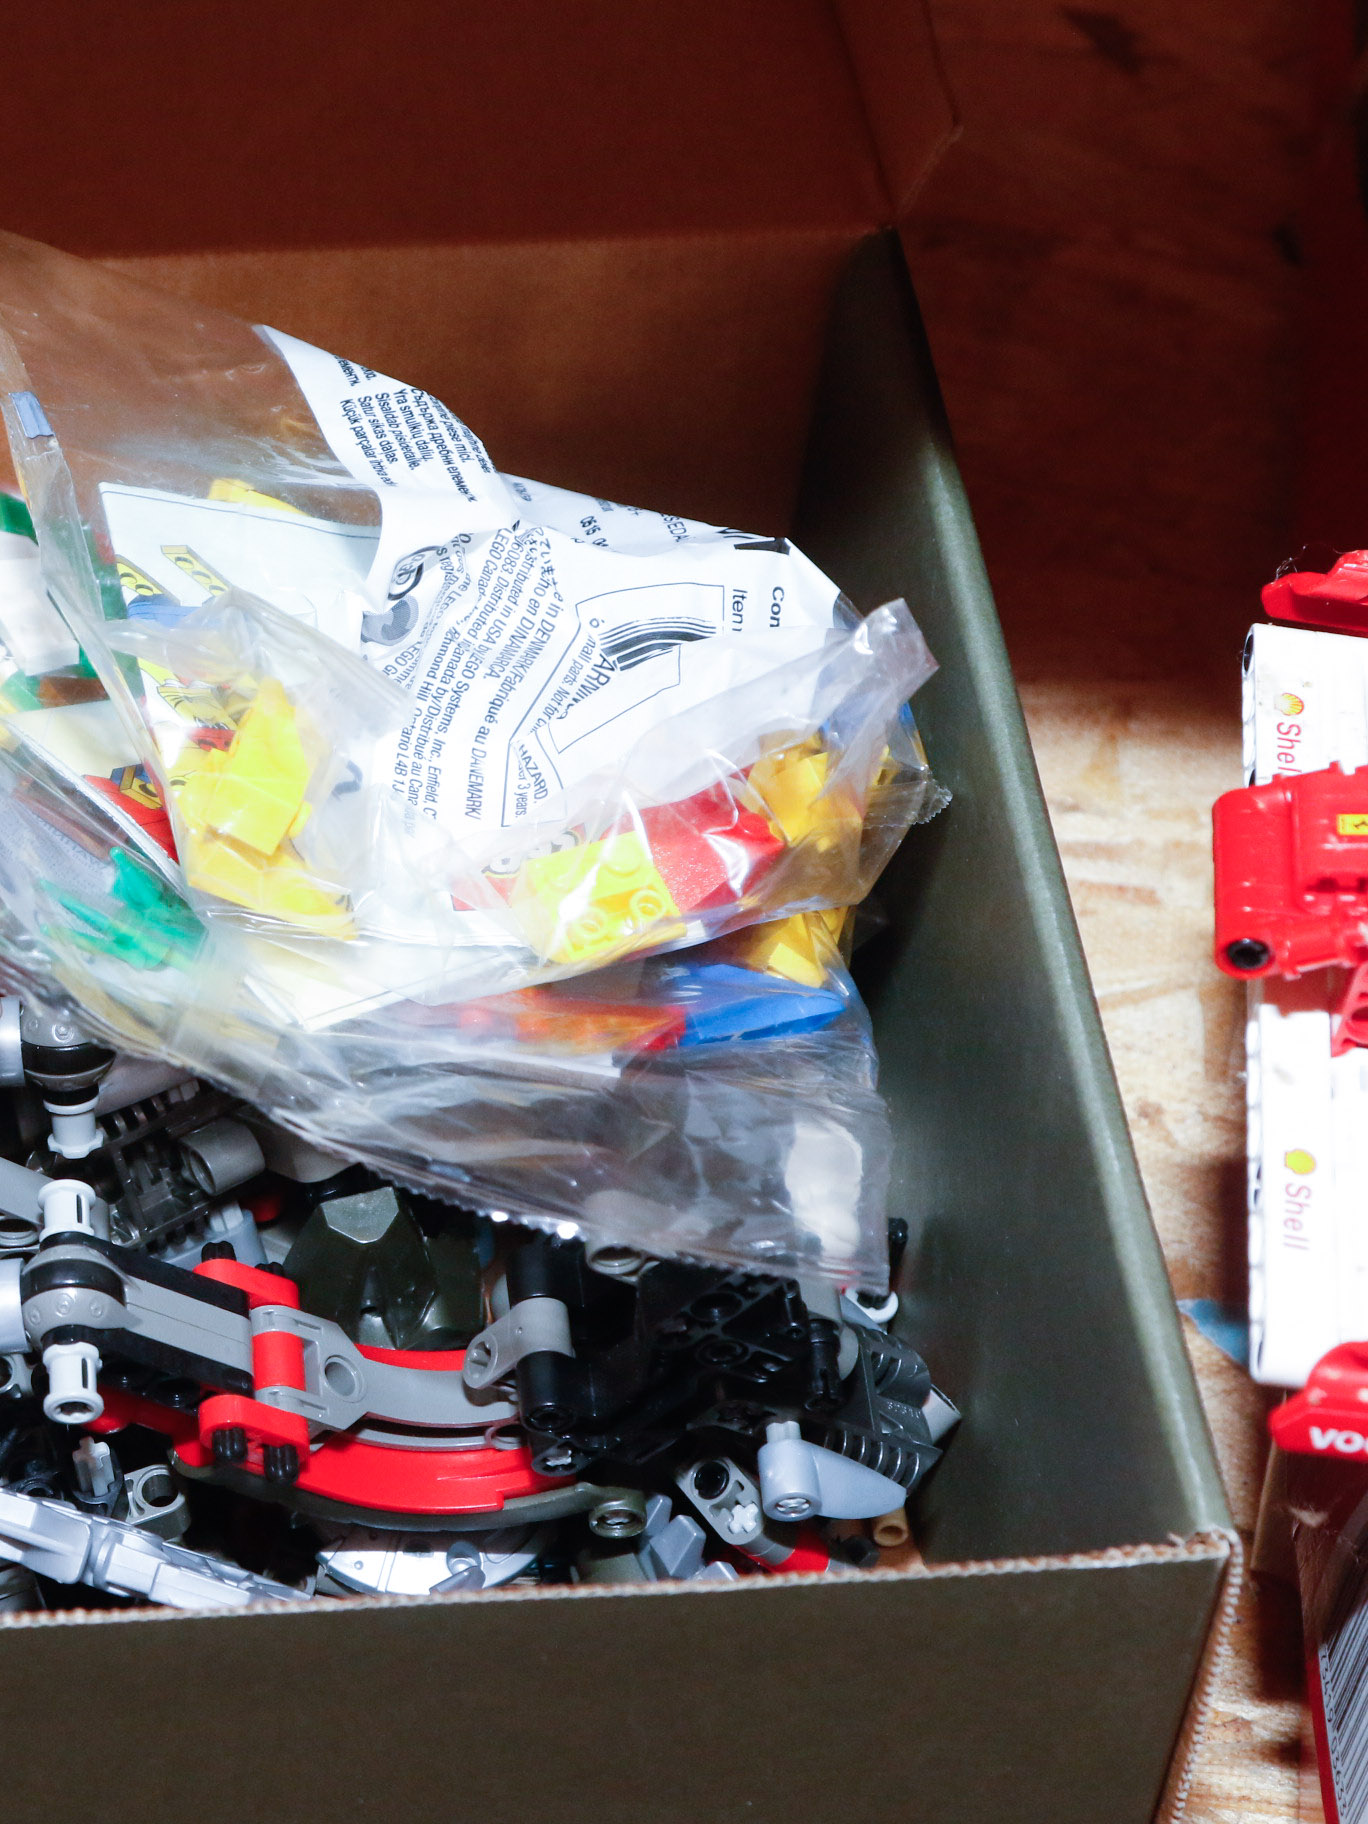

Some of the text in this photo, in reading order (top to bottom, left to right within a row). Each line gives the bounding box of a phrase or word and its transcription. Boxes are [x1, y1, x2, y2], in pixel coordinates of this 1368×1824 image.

[467, 575, 510, 640] Distributed
[526, 598, 541, 616] en
[545, 602, 564, 618] in
[482, 619, 507, 644] USA
[561, 659, 584, 686] parts.
[434, 680, 470, 735] Systems,
[550, 686, 571, 706] Not
[542, 702, 559, 720] for
[474, 725, 491, 745] au
[393, 752, 410, 777] L4B
[410, 761, 423, 776] au
[518, 744, 549, 804] HAZARD.
[517, 782, 531, 790] 3
[514, 791, 528, 818] years.
[1282, 1182, 1313, 1252] Shell
